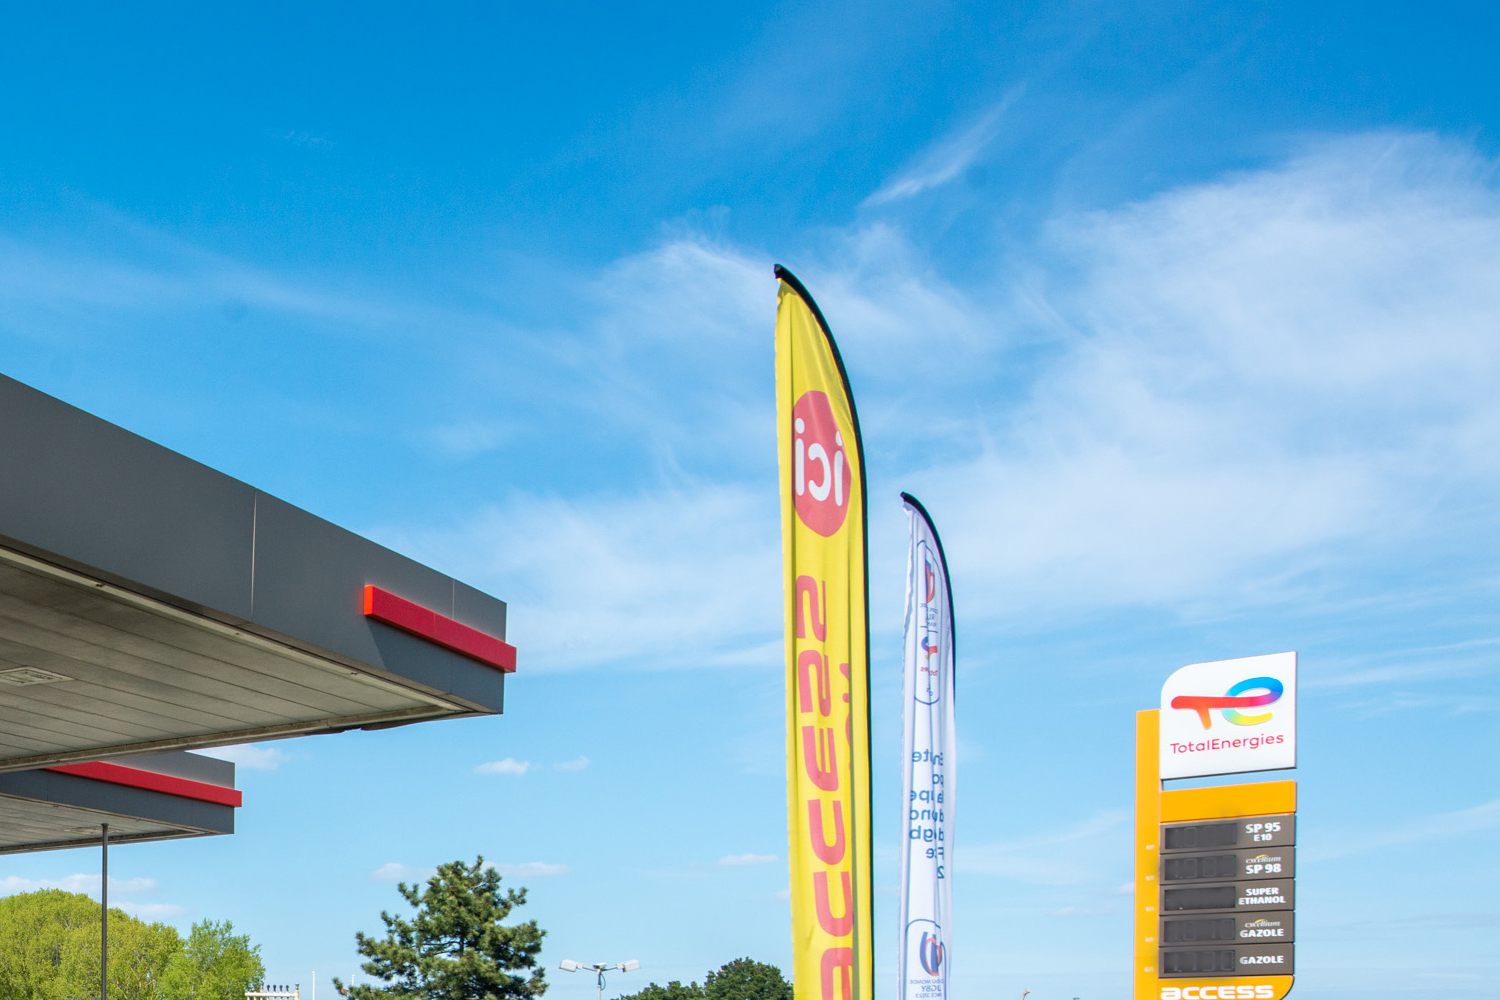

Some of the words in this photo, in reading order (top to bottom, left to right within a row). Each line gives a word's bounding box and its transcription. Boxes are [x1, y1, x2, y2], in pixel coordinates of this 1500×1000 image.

[1170, 733, 1284, 754] TotalEnergies
[1245, 823, 1263, 834] SP
[1265, 822, 1281, 833] 95
[1254, 833, 1272, 841] E10
[1245, 865, 1263, 875] SP
[1265, 863, 1281, 874] 98
[1245, 887, 1279, 896] SUPER
[1238, 896, 1286, 905] ETHANOL
[1239, 928, 1284, 938] GAZOLE
[1239, 955, 1284, 965] GAZOLE
[1160, 985, 1274, 1000] access
